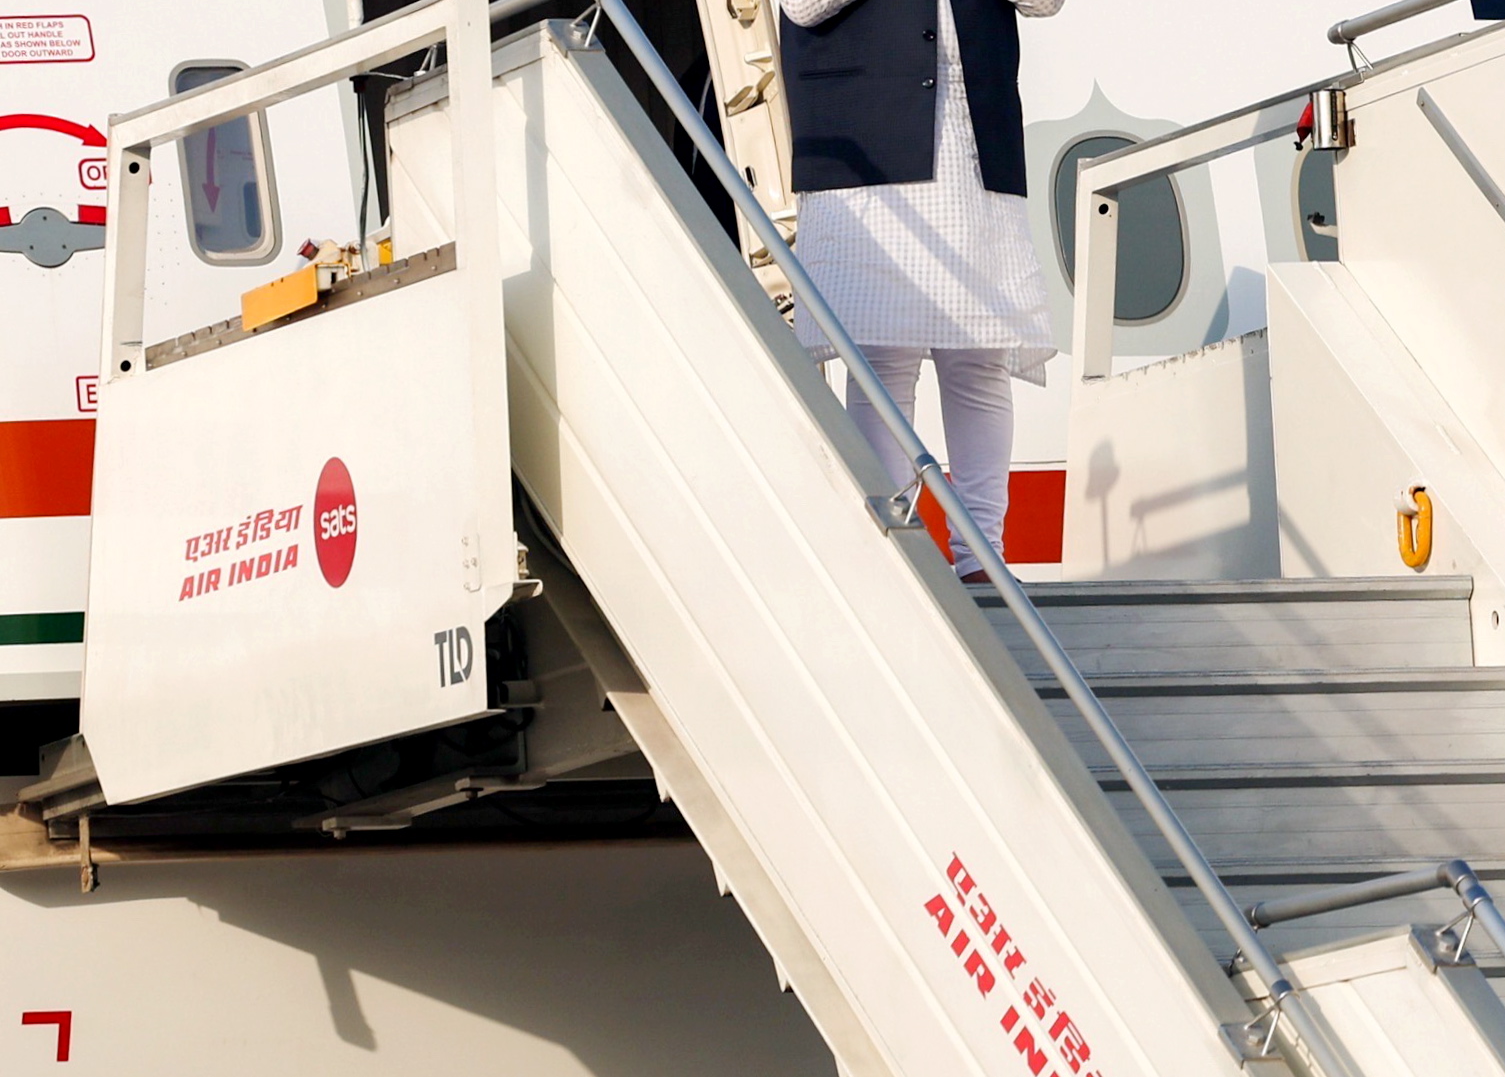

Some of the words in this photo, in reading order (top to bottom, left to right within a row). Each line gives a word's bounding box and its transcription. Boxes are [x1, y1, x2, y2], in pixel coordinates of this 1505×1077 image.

[36, 21, 64, 29] FLAPS
[1, 50, 27, 58] DOOR
[29, 49, 74, 57] OUTWARD
[14, 40, 47, 48] SHOWN
[49, 39, 81, 47] BELOW
[320, 504, 356, 540] sats
[179, 568, 221, 602] AIR
[228, 544, 299, 587] INDIA
[434, 626, 473, 688] TLD
[924, 893, 996, 1000] AIR
[1000, 1004, 1062, 1077] IN
